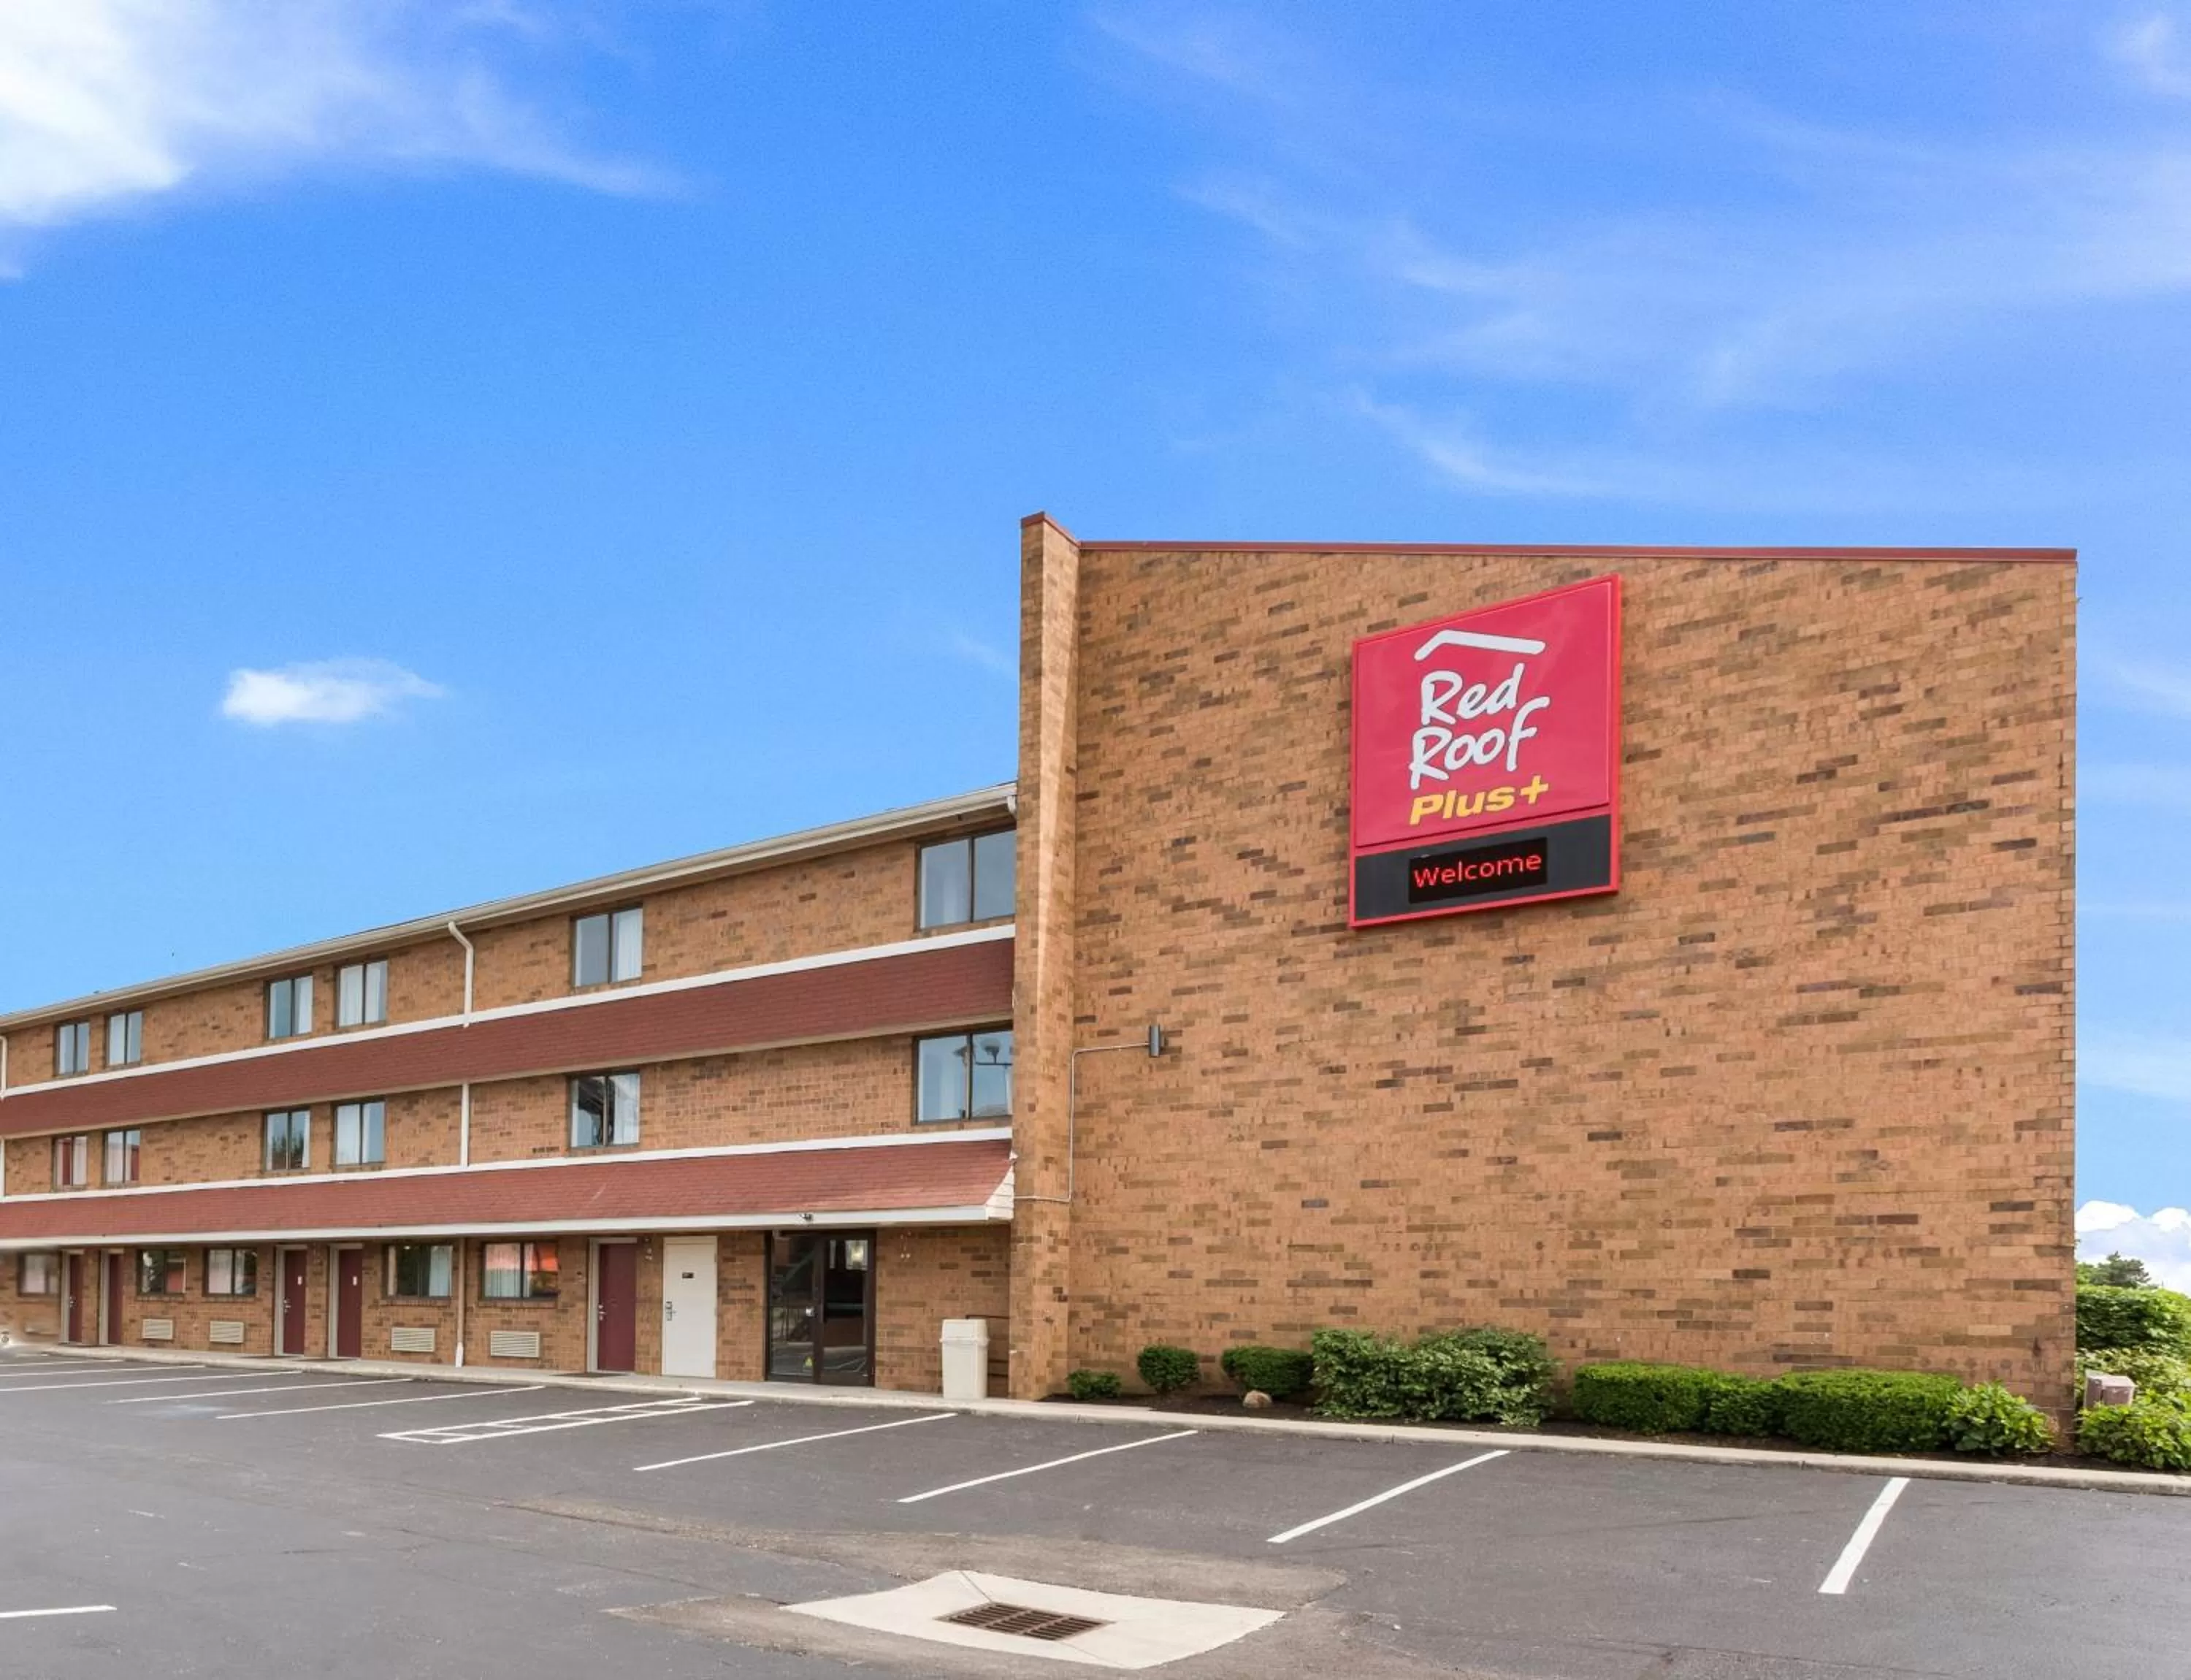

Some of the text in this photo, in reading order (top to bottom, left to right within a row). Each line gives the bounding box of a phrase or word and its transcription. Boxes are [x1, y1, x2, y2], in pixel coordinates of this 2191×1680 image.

[1420, 663, 1524, 725] Red
[1409, 696, 1550, 790] Roof
[1410, 775, 1549, 825] Plus+
[1413, 853, 1542, 888] Welcome
